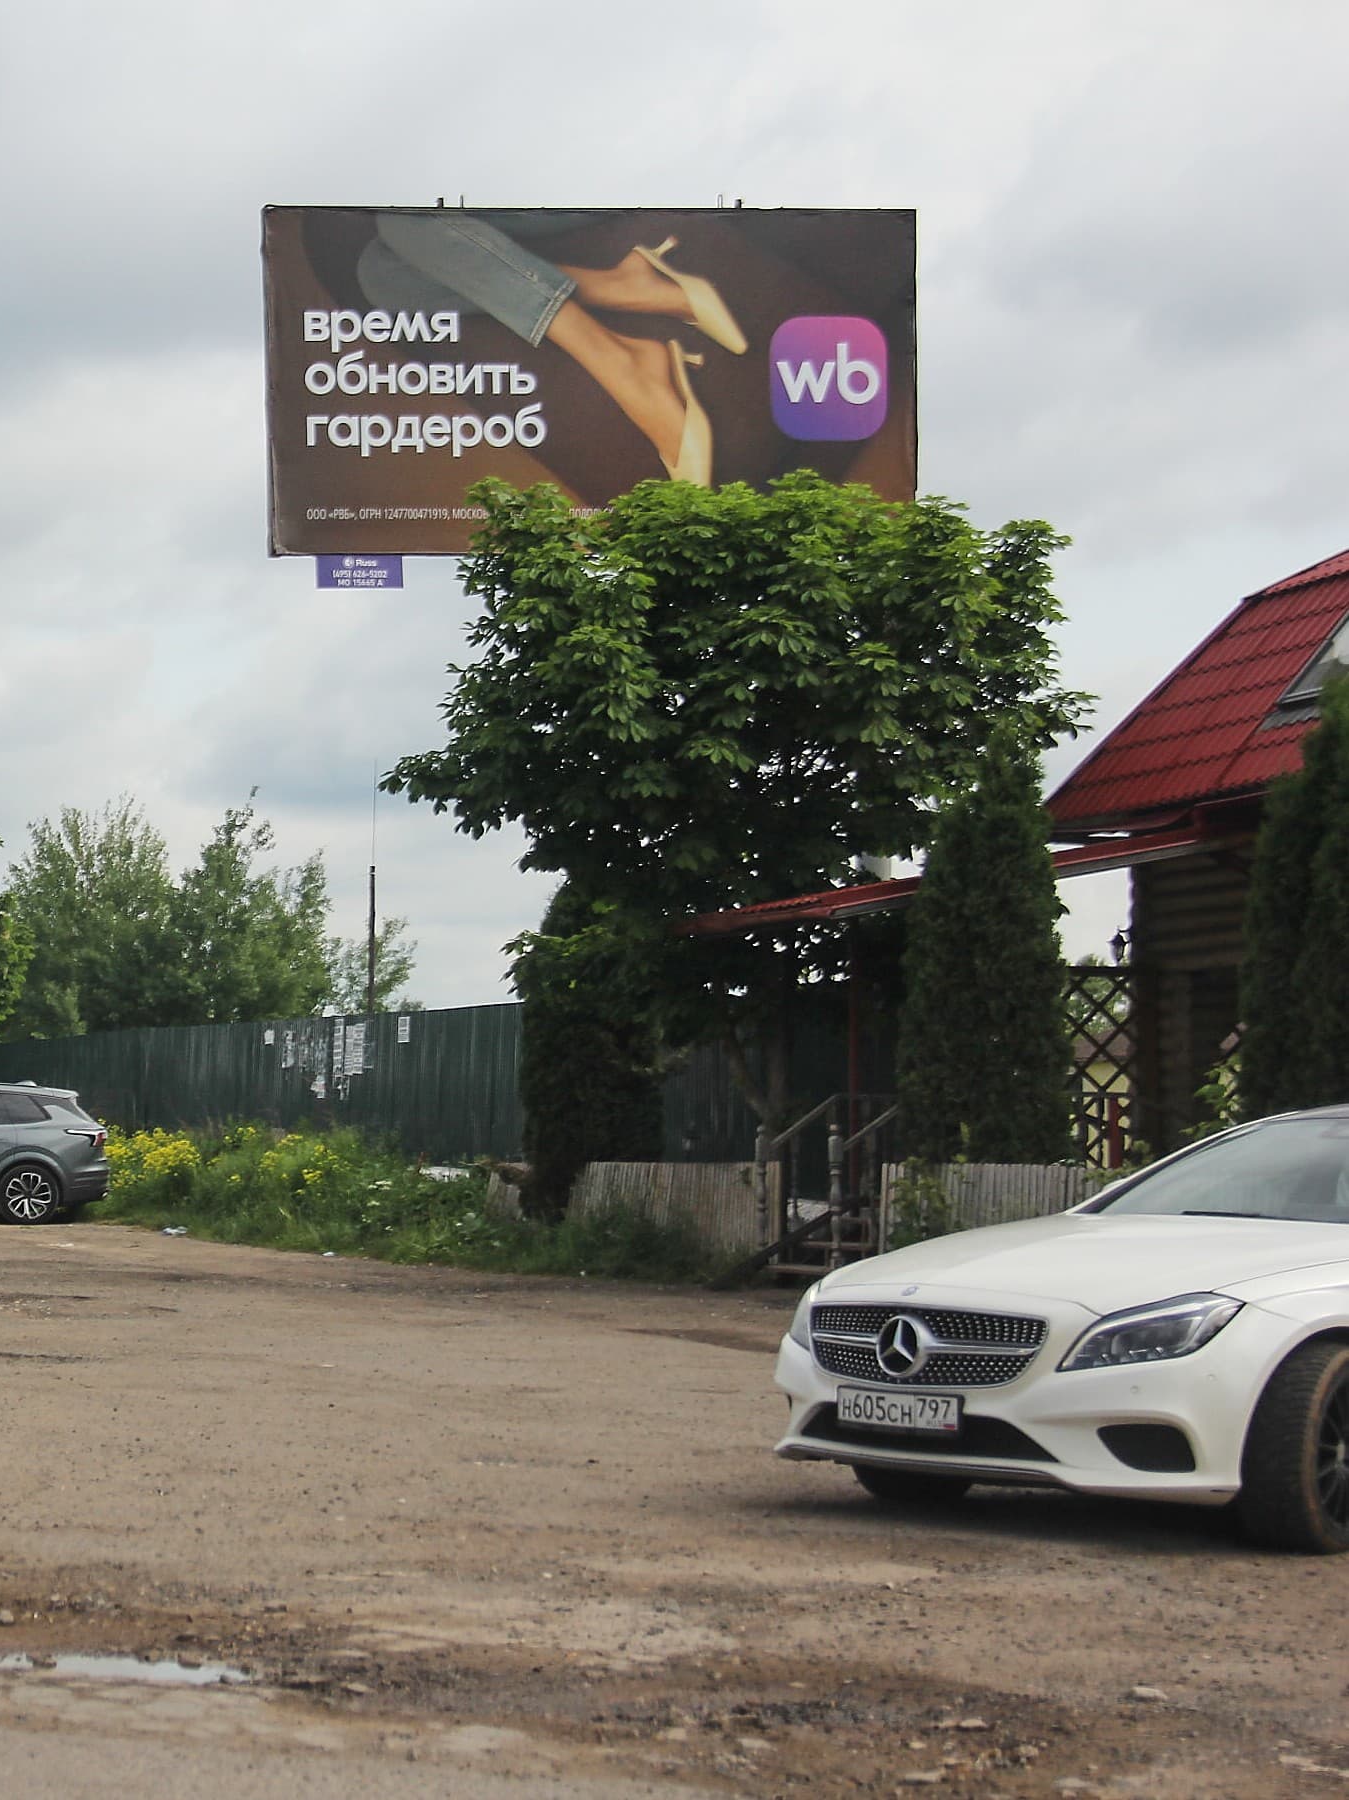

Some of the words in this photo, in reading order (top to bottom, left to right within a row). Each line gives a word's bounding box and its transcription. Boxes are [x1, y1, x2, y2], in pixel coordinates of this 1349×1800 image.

[303, 310, 459, 353] время
[304, 351, 537, 395] обновить
[776, 343, 880, 404] wb
[306, 402, 547, 457] гардероб
[306, 508, 327, 520] ООО
[359, 508, 381, 520] ОГРН
[917, 1398, 951, 1420] 797
